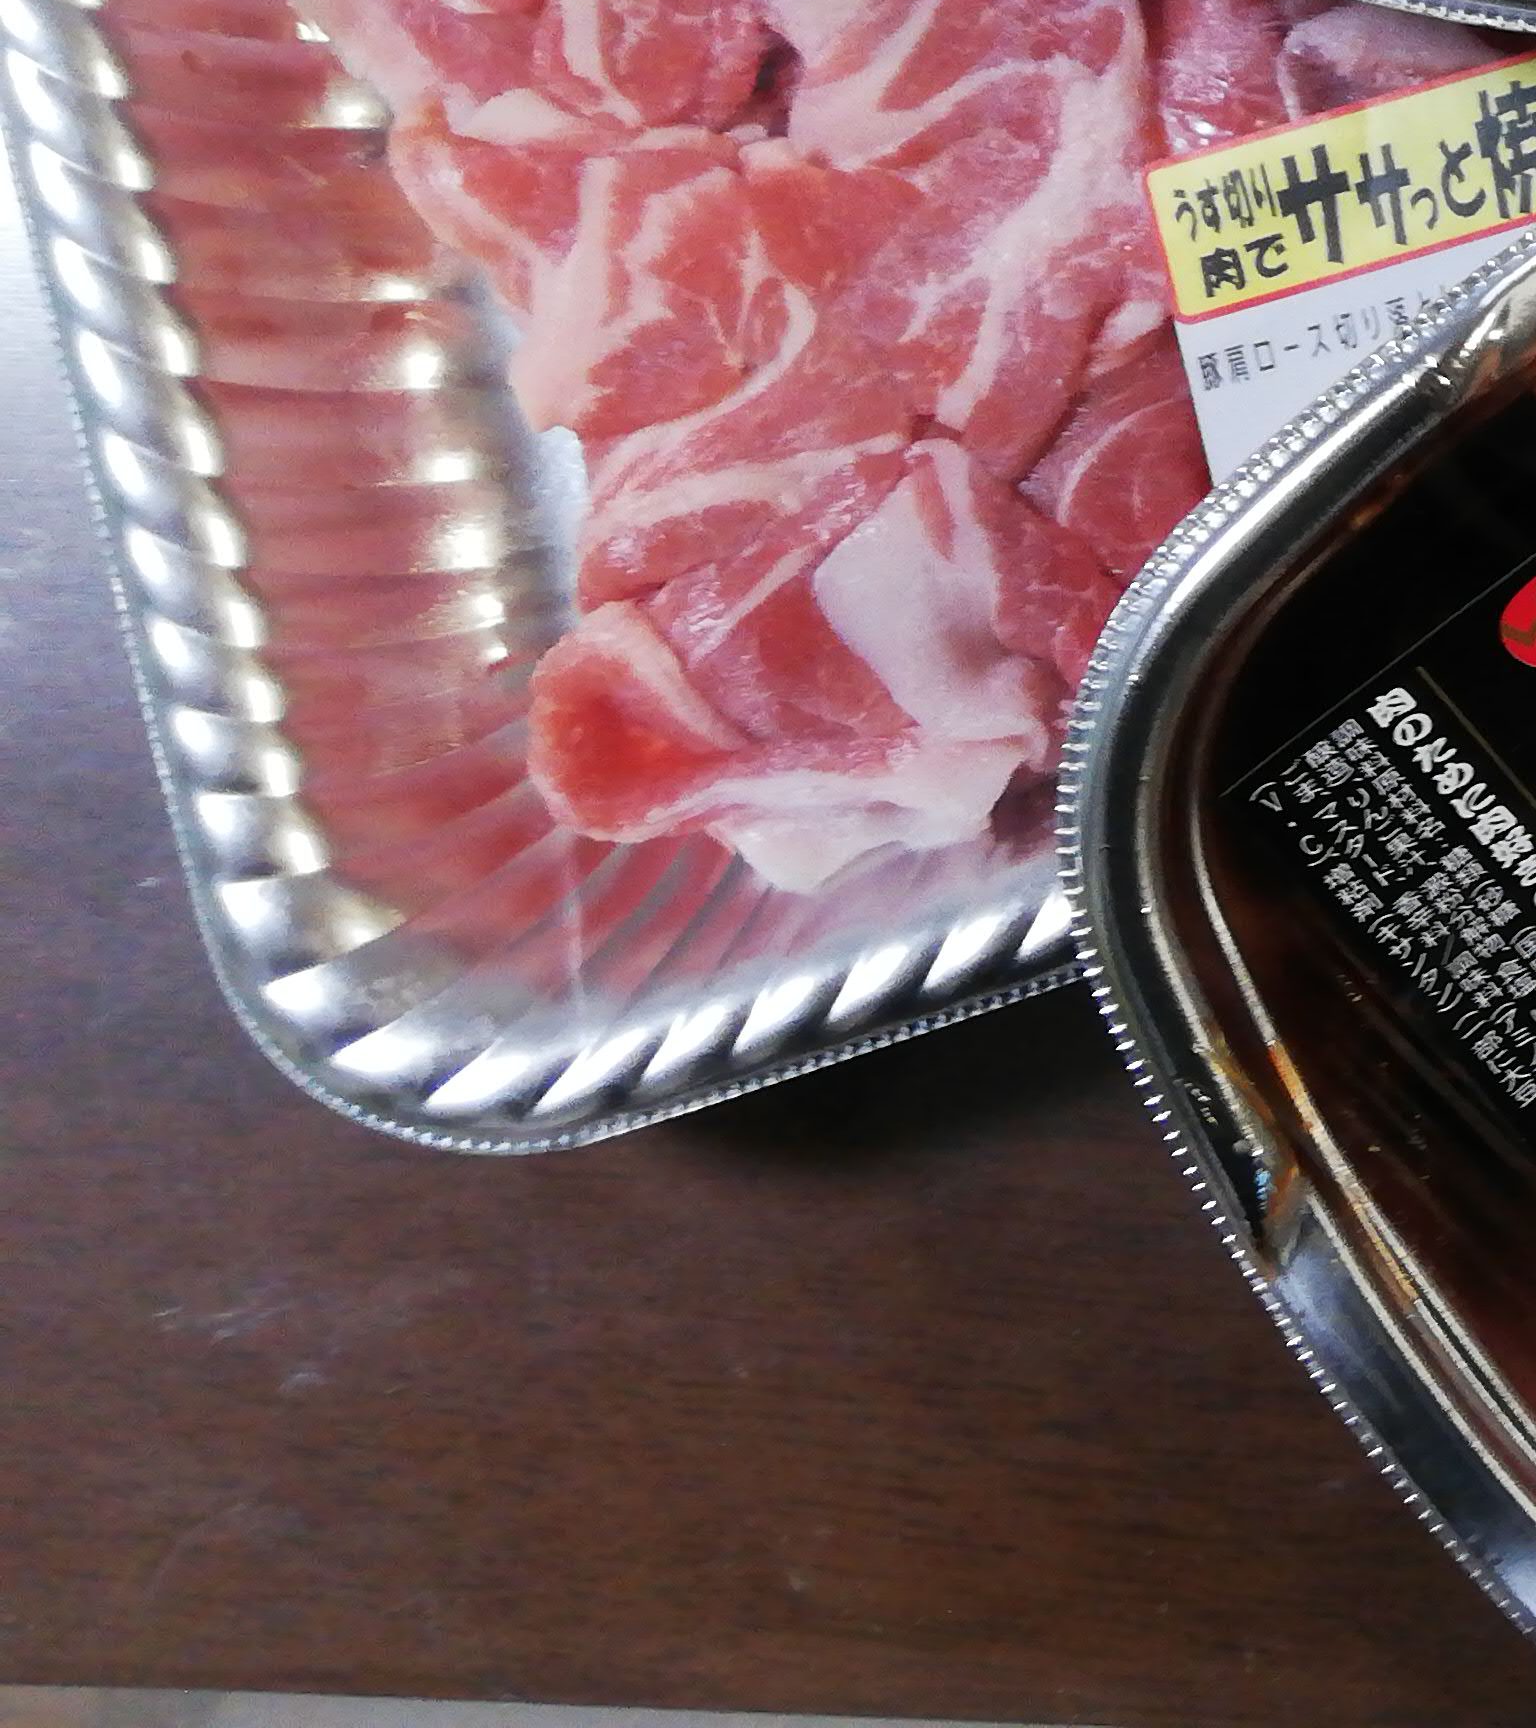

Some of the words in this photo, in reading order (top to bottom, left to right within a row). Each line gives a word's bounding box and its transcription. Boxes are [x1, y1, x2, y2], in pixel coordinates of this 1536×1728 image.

[1173, 162, 1278, 243] うす切り
[1200, 235, 1288, 298] 肉で
